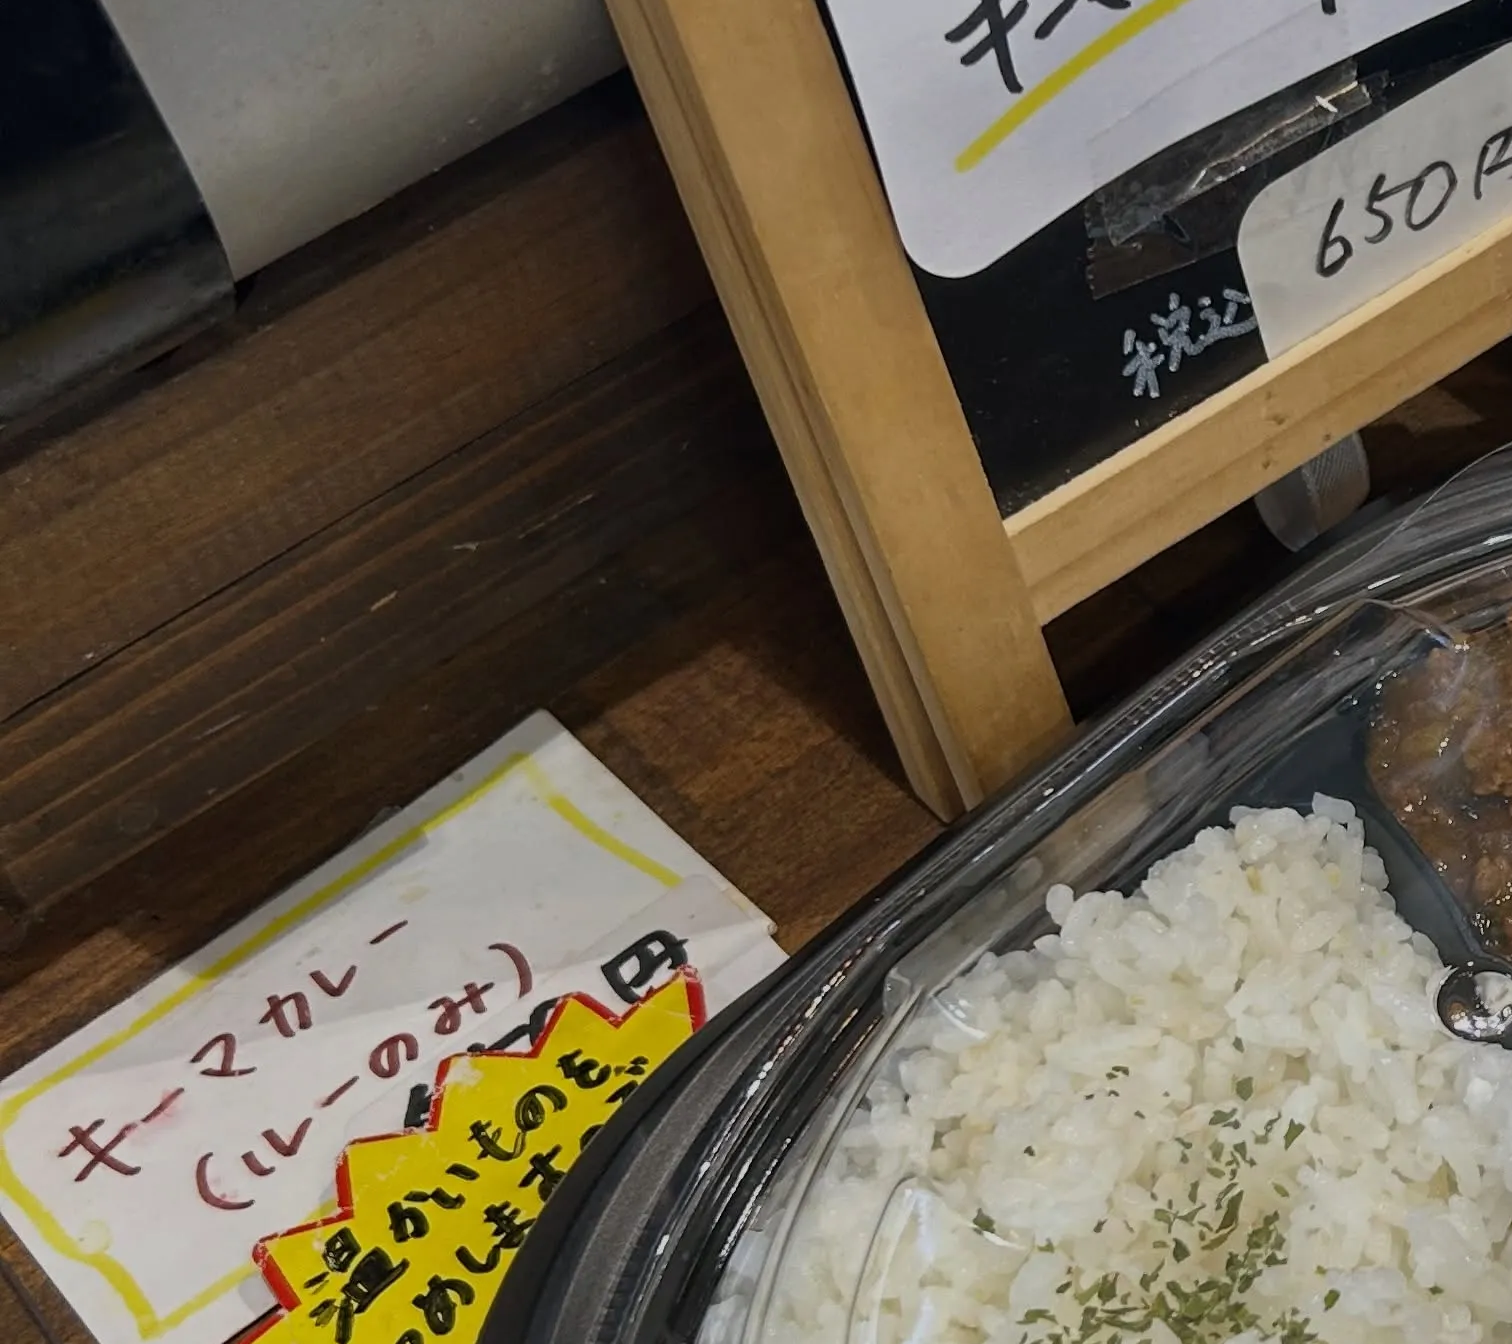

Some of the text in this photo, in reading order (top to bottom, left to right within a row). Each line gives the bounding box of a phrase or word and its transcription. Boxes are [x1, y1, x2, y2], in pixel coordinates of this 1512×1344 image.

[1122, 288, 1258, 398] 税込
[57, 919, 409, 1183] キーマカレー
